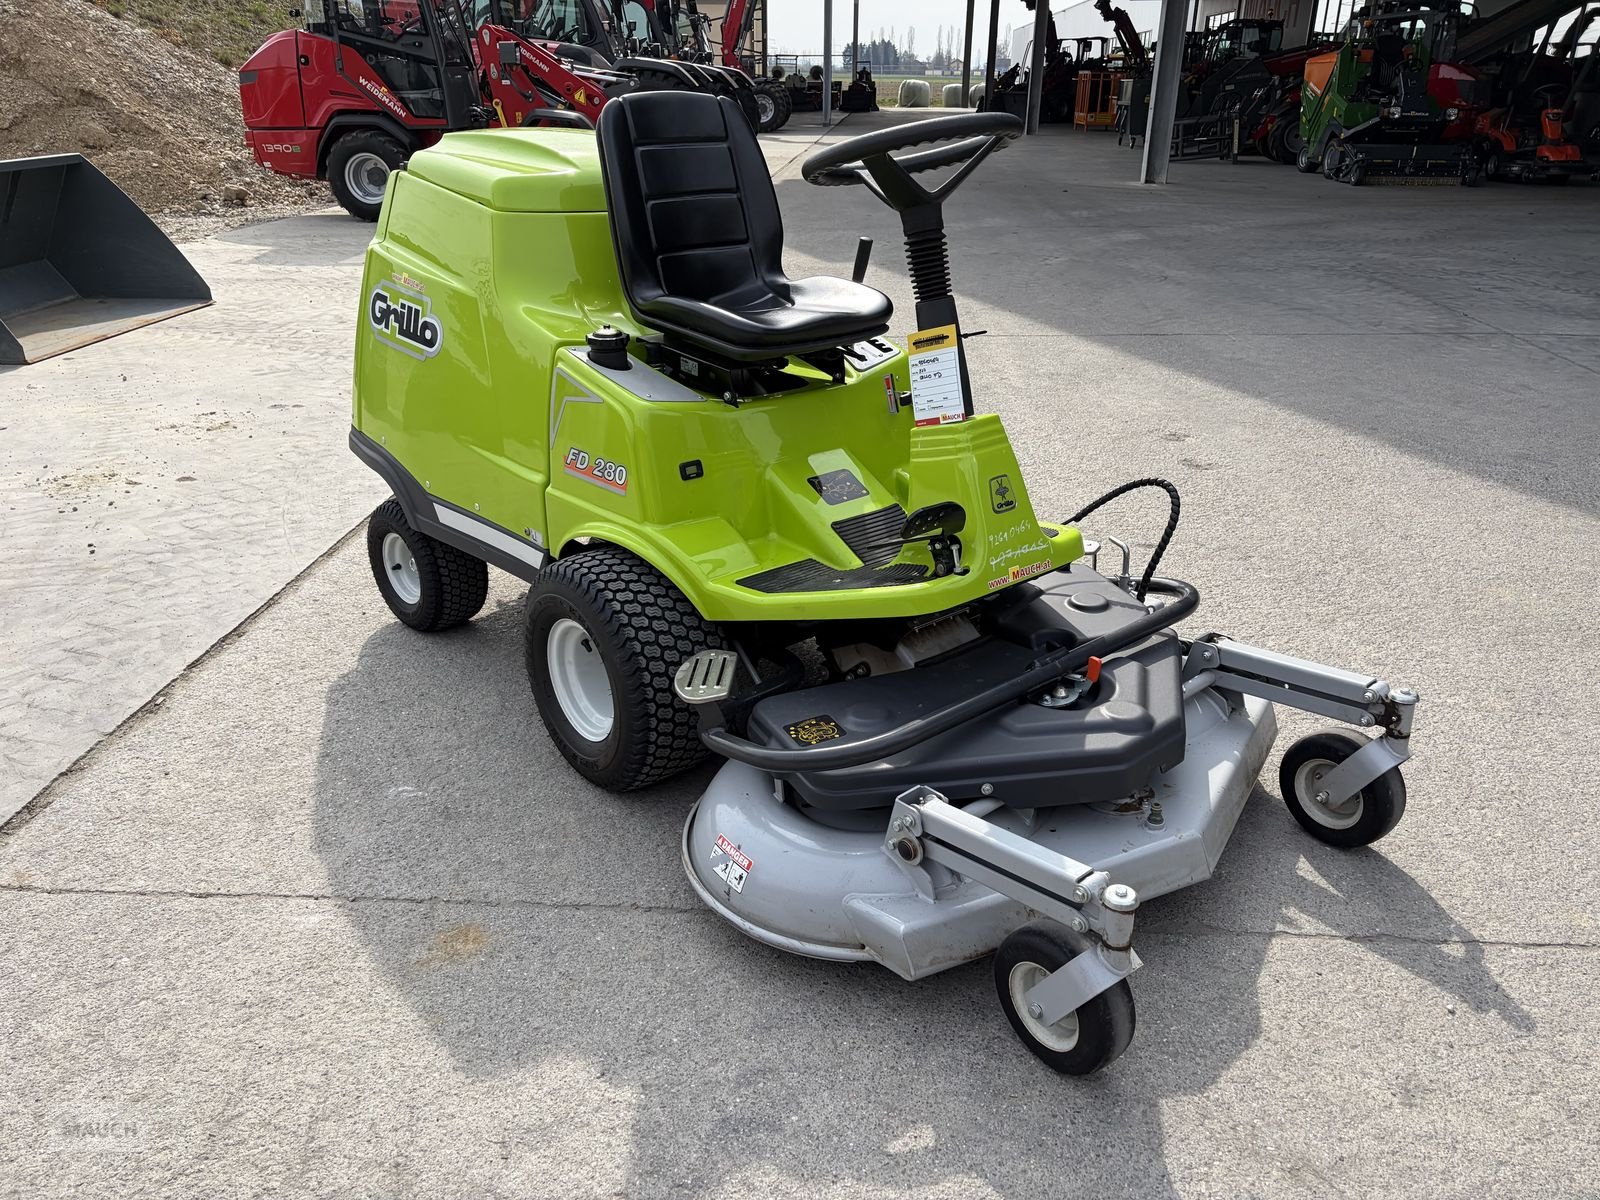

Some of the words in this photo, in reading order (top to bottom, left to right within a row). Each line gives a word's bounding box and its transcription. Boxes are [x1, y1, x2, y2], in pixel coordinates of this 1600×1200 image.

[359, 75, 407, 118] WEIDEMANN
[370, 290, 440, 351] Grillo
[565, 447, 590, 471] FD
[592, 457, 629, 487] 280
[996, 499, 1015, 510] Grillo
[721, 840, 750, 869] DANGER
